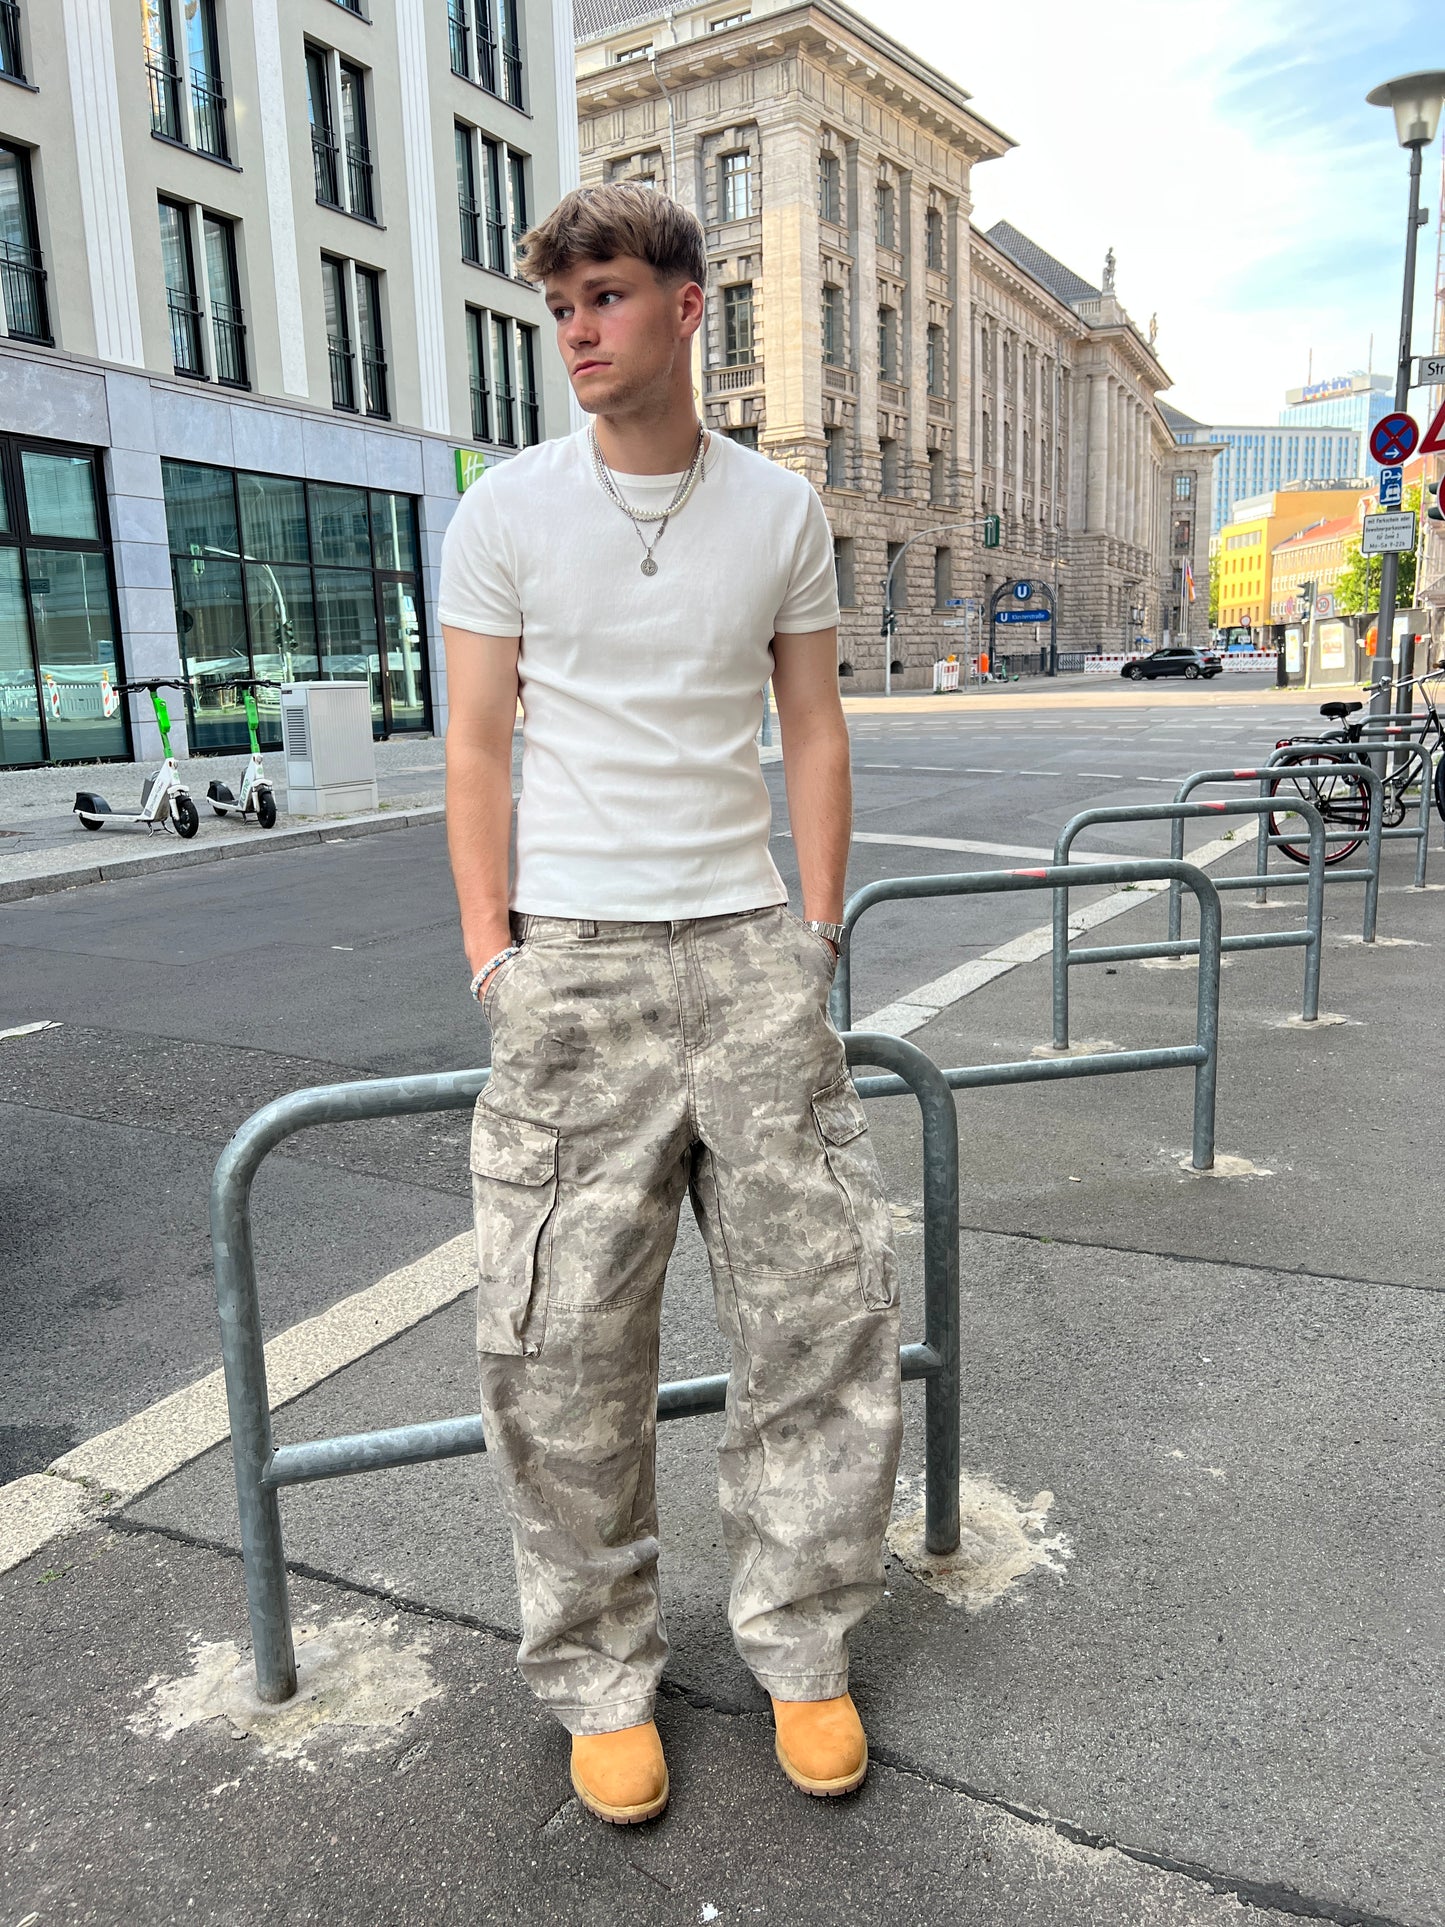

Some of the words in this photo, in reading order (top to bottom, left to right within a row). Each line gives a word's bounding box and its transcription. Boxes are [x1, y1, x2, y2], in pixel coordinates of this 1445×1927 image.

[1382, 470, 1392, 485] P
[1017, 585, 1027, 598] U
[1000, 612, 1008, 622] U
